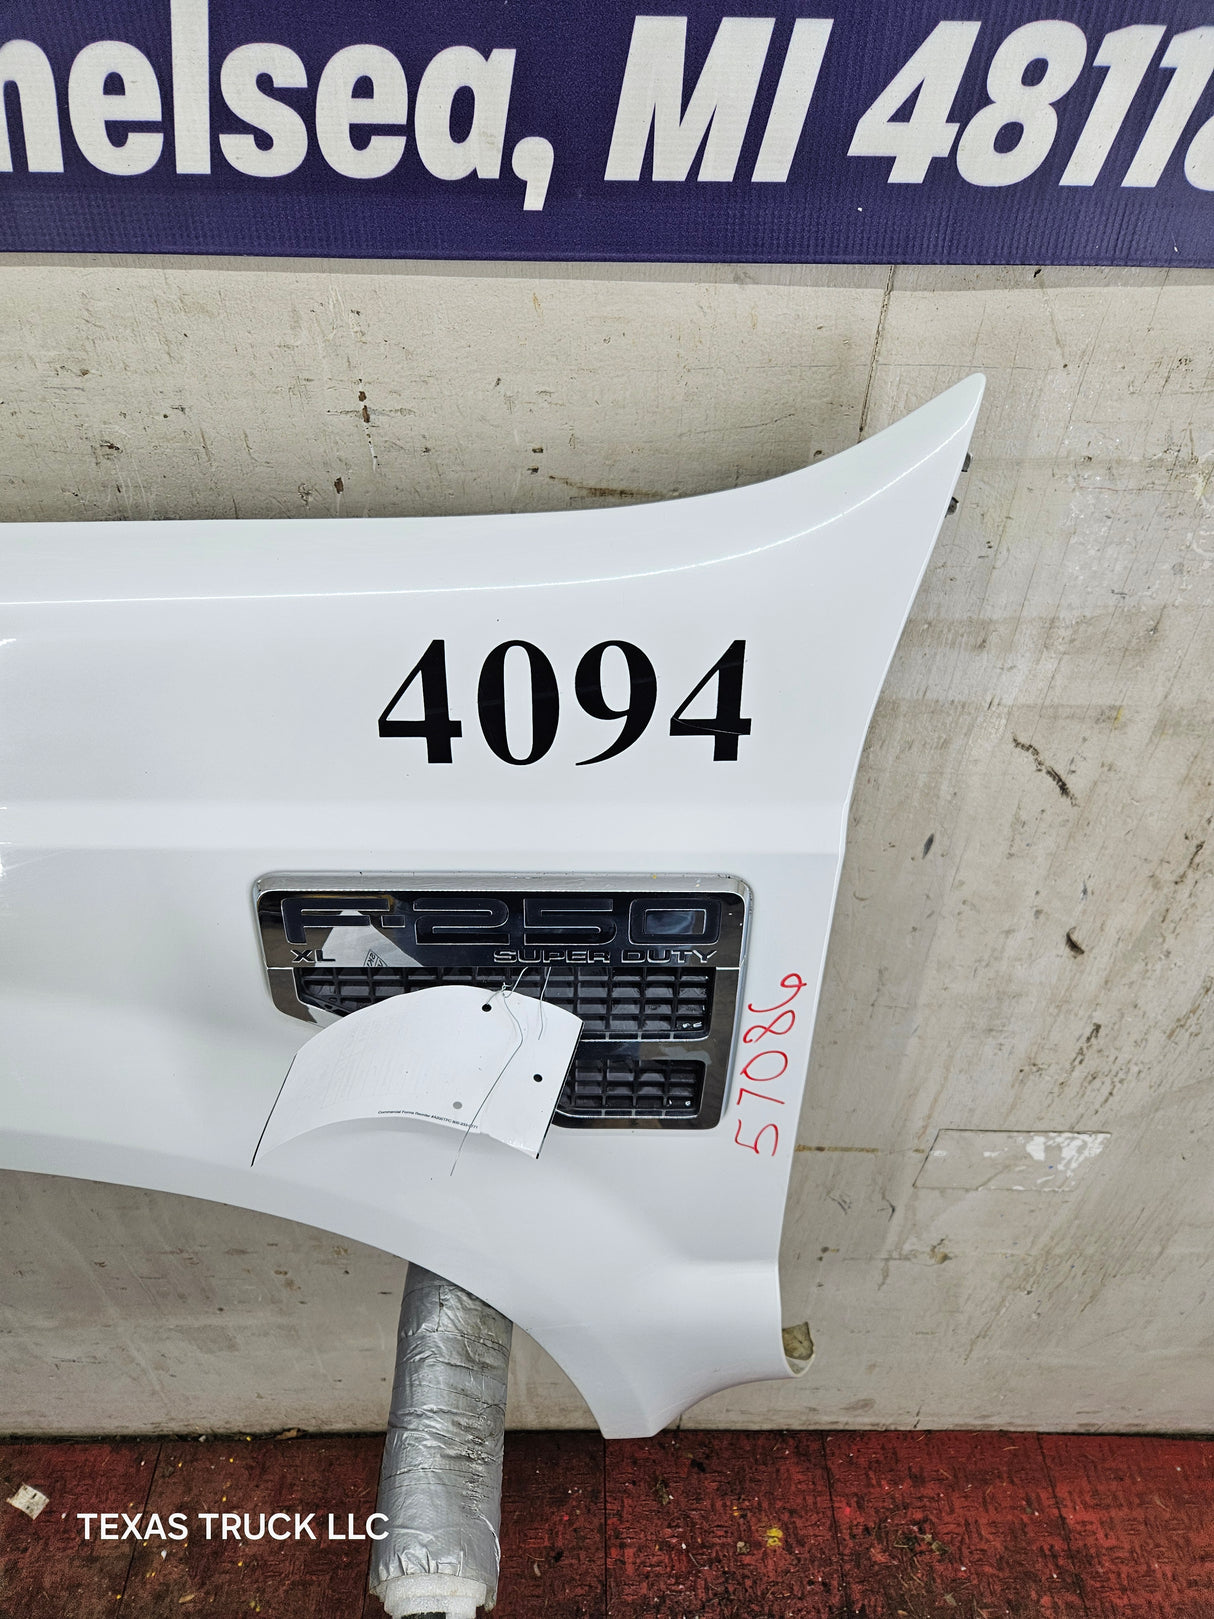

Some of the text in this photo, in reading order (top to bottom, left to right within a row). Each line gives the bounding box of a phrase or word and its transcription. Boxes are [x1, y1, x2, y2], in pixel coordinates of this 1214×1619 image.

[604, 15, 834, 182] MI
[378, 639, 752, 766] 4094
[281, 897, 722, 947] F-250
[290, 949, 718, 964] XL SUPER DUTY
[734, 972, 808, 1157] 57086
